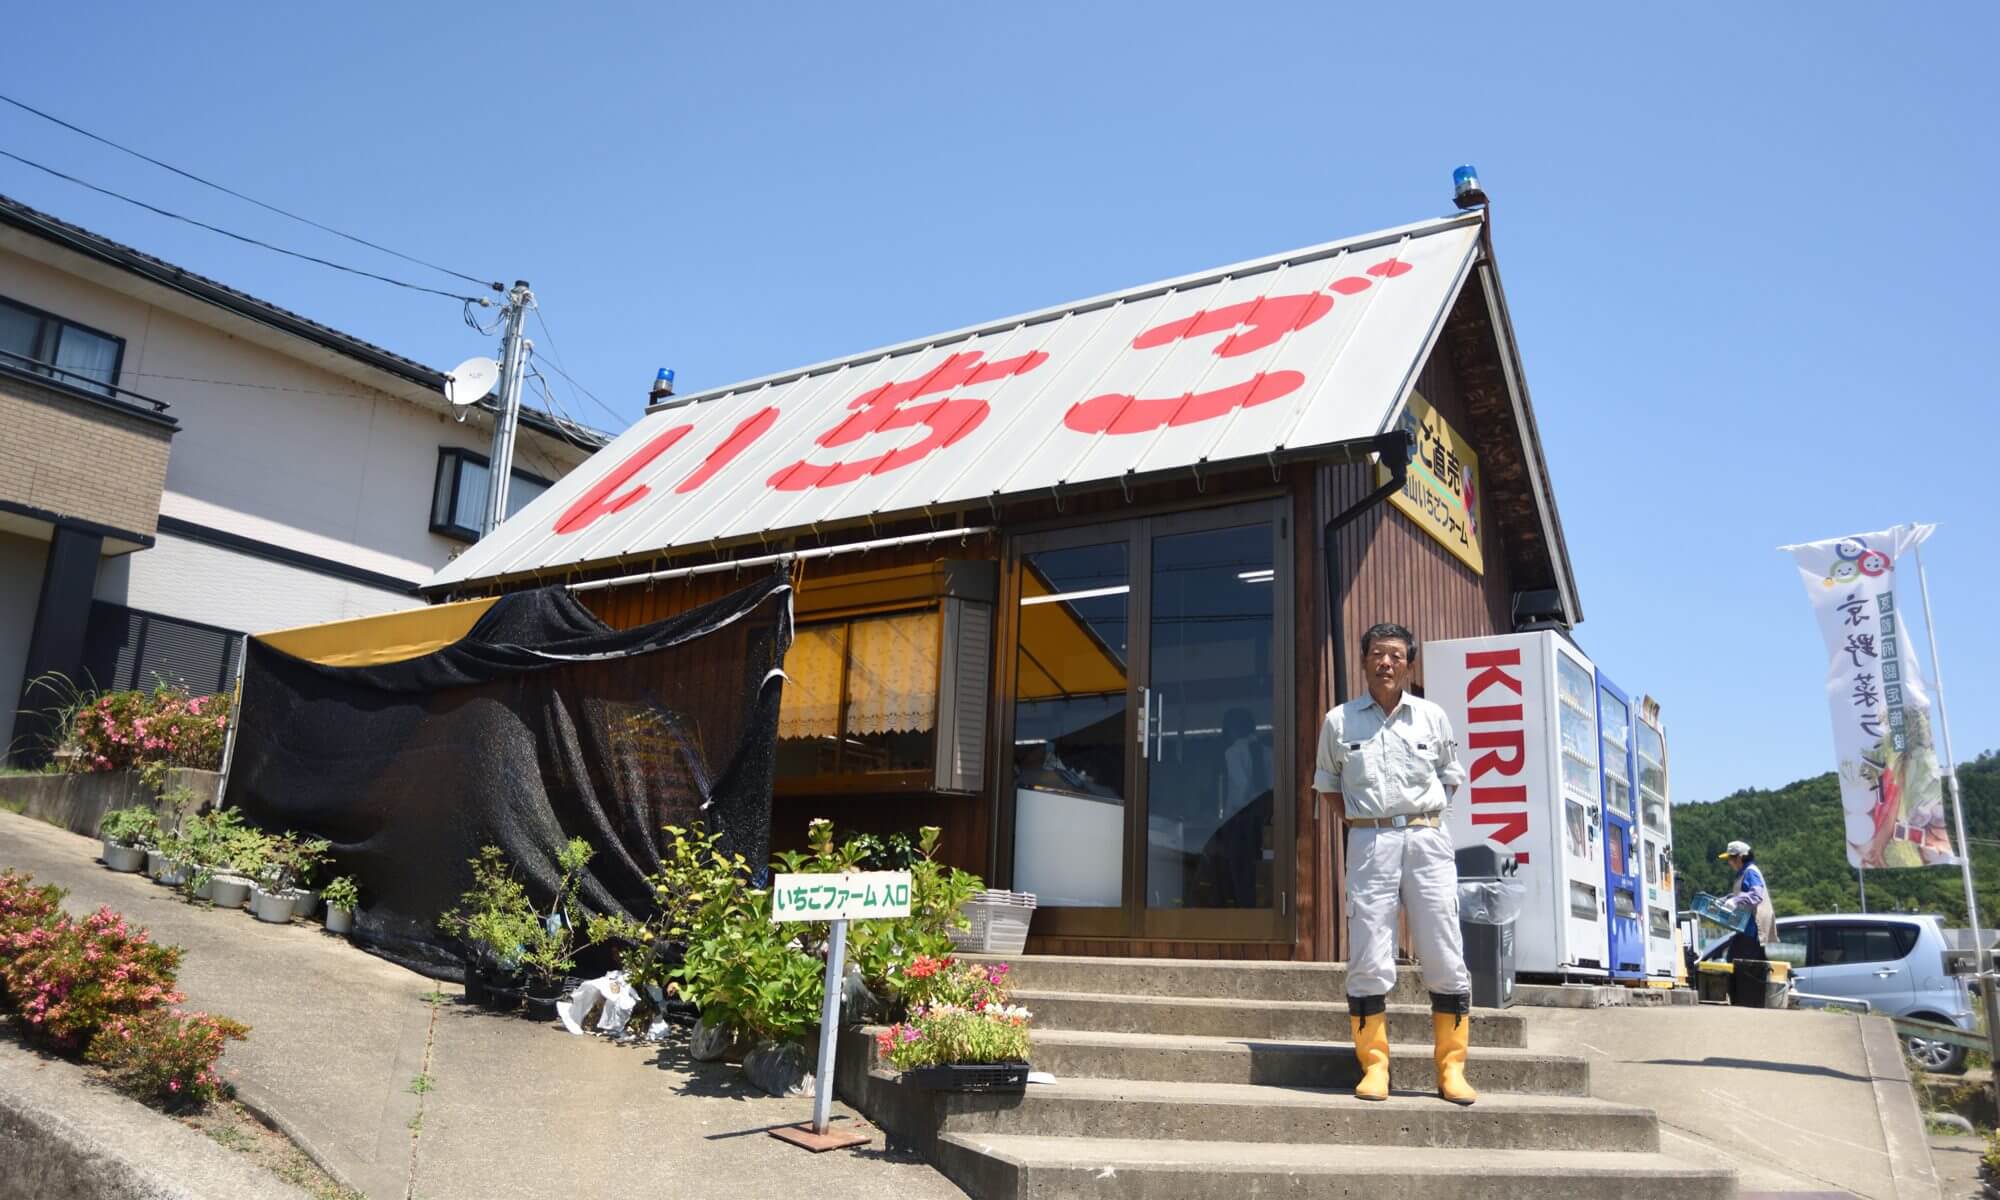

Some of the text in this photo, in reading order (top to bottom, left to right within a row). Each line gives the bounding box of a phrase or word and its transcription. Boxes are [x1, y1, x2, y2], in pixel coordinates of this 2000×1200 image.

[553, 258, 1413, 535] いちご
[777, 884, 908, 911] いちごファーム 入口
